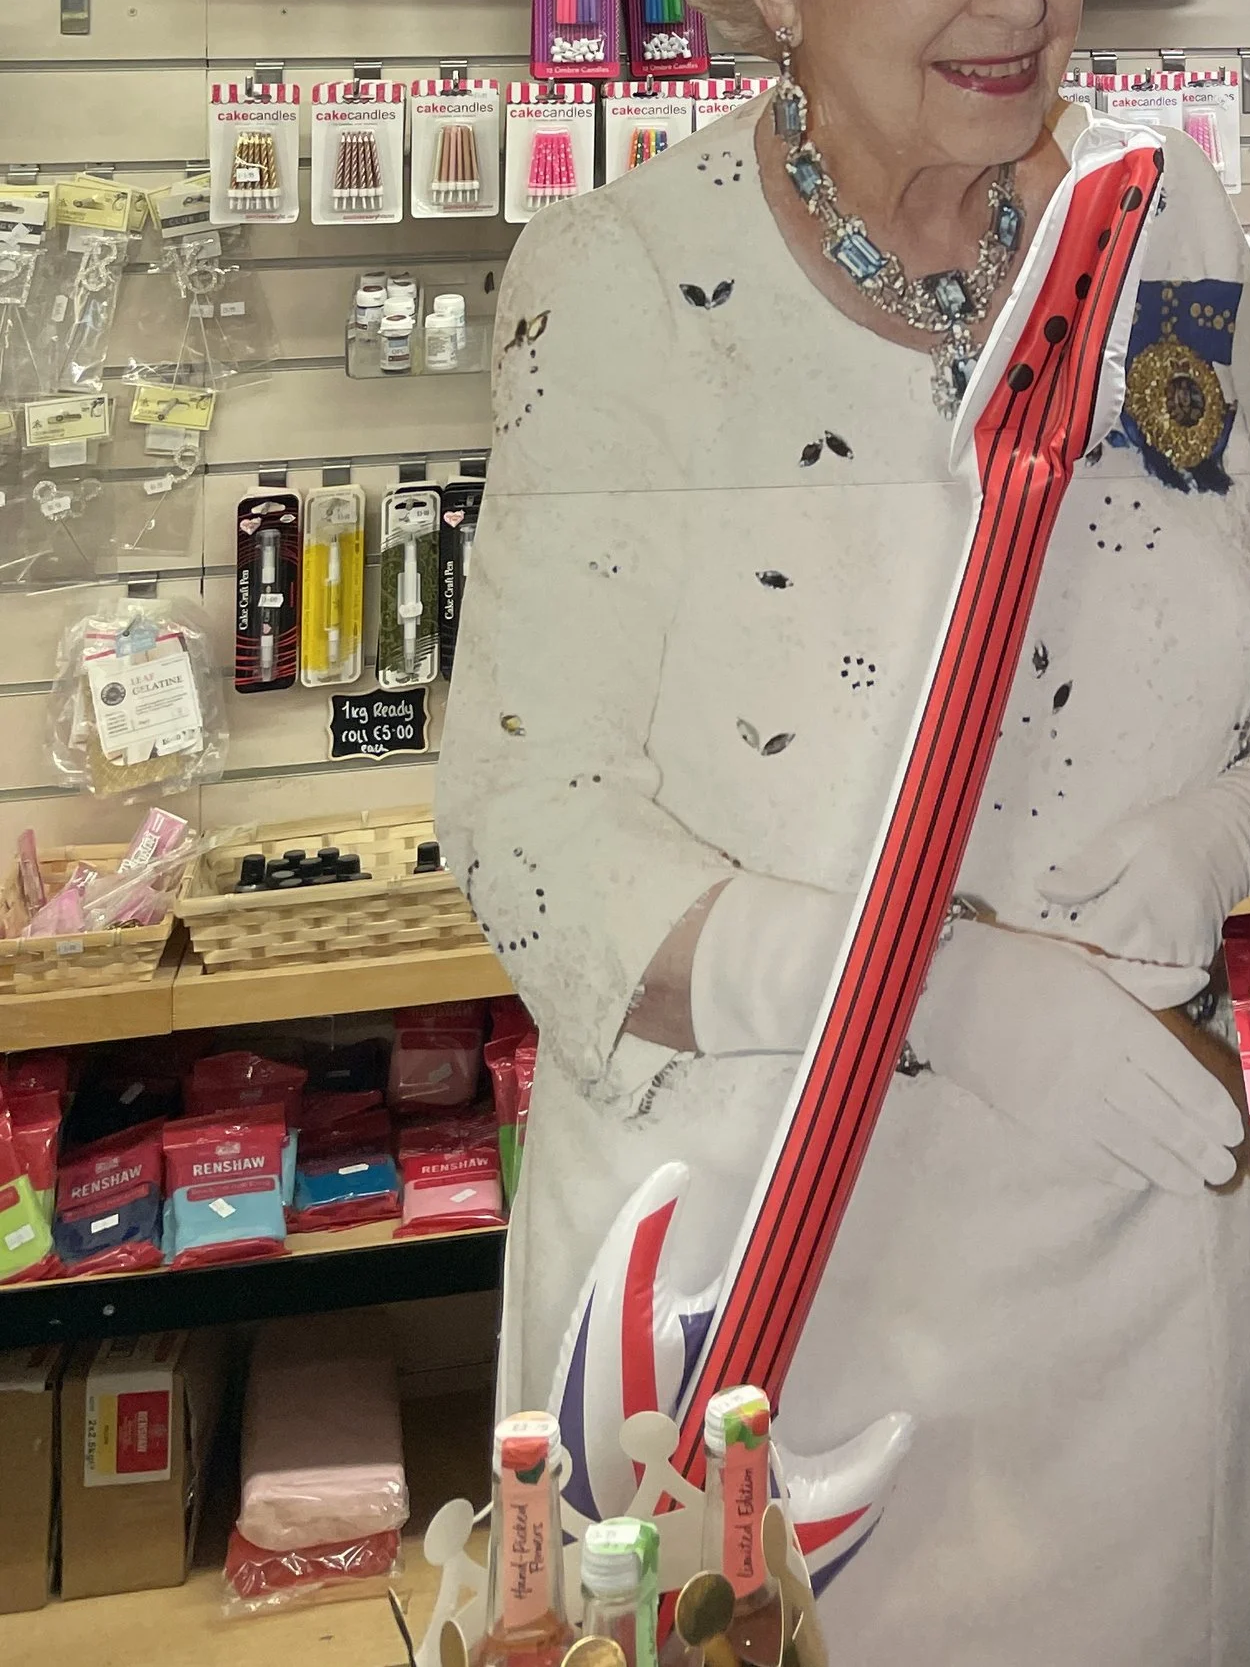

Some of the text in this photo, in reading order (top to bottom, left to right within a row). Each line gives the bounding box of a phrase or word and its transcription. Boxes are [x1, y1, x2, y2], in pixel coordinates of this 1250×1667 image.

[416, 102, 494, 113] cakecandles
[612, 105, 687, 116] cakecandles
[1112, 96, 1177, 107] cakecandles
[217, 110, 297, 122] cakecandles
[316, 109, 396, 121] cakecandles
[510, 107, 592, 118] cakecandles
[444, 560, 454, 620] Cake Craft Pen
[238, 569, 249, 631] Cake Craft Pen
[132, 675, 183, 696] GELATINE
[341, 699, 414, 724] 1kg Ready
[341, 729, 368, 743] roll
[360, 743, 390, 753] each
[193, 1155, 266, 1177] RENSHAW
[421, 1157, 489, 1175] RENSHAW
[71, 1164, 143, 1199] RENSHAW
[736, 1467, 753, 1579] Limited Edition
[510, 1502, 533, 1601] Hand-Picked
